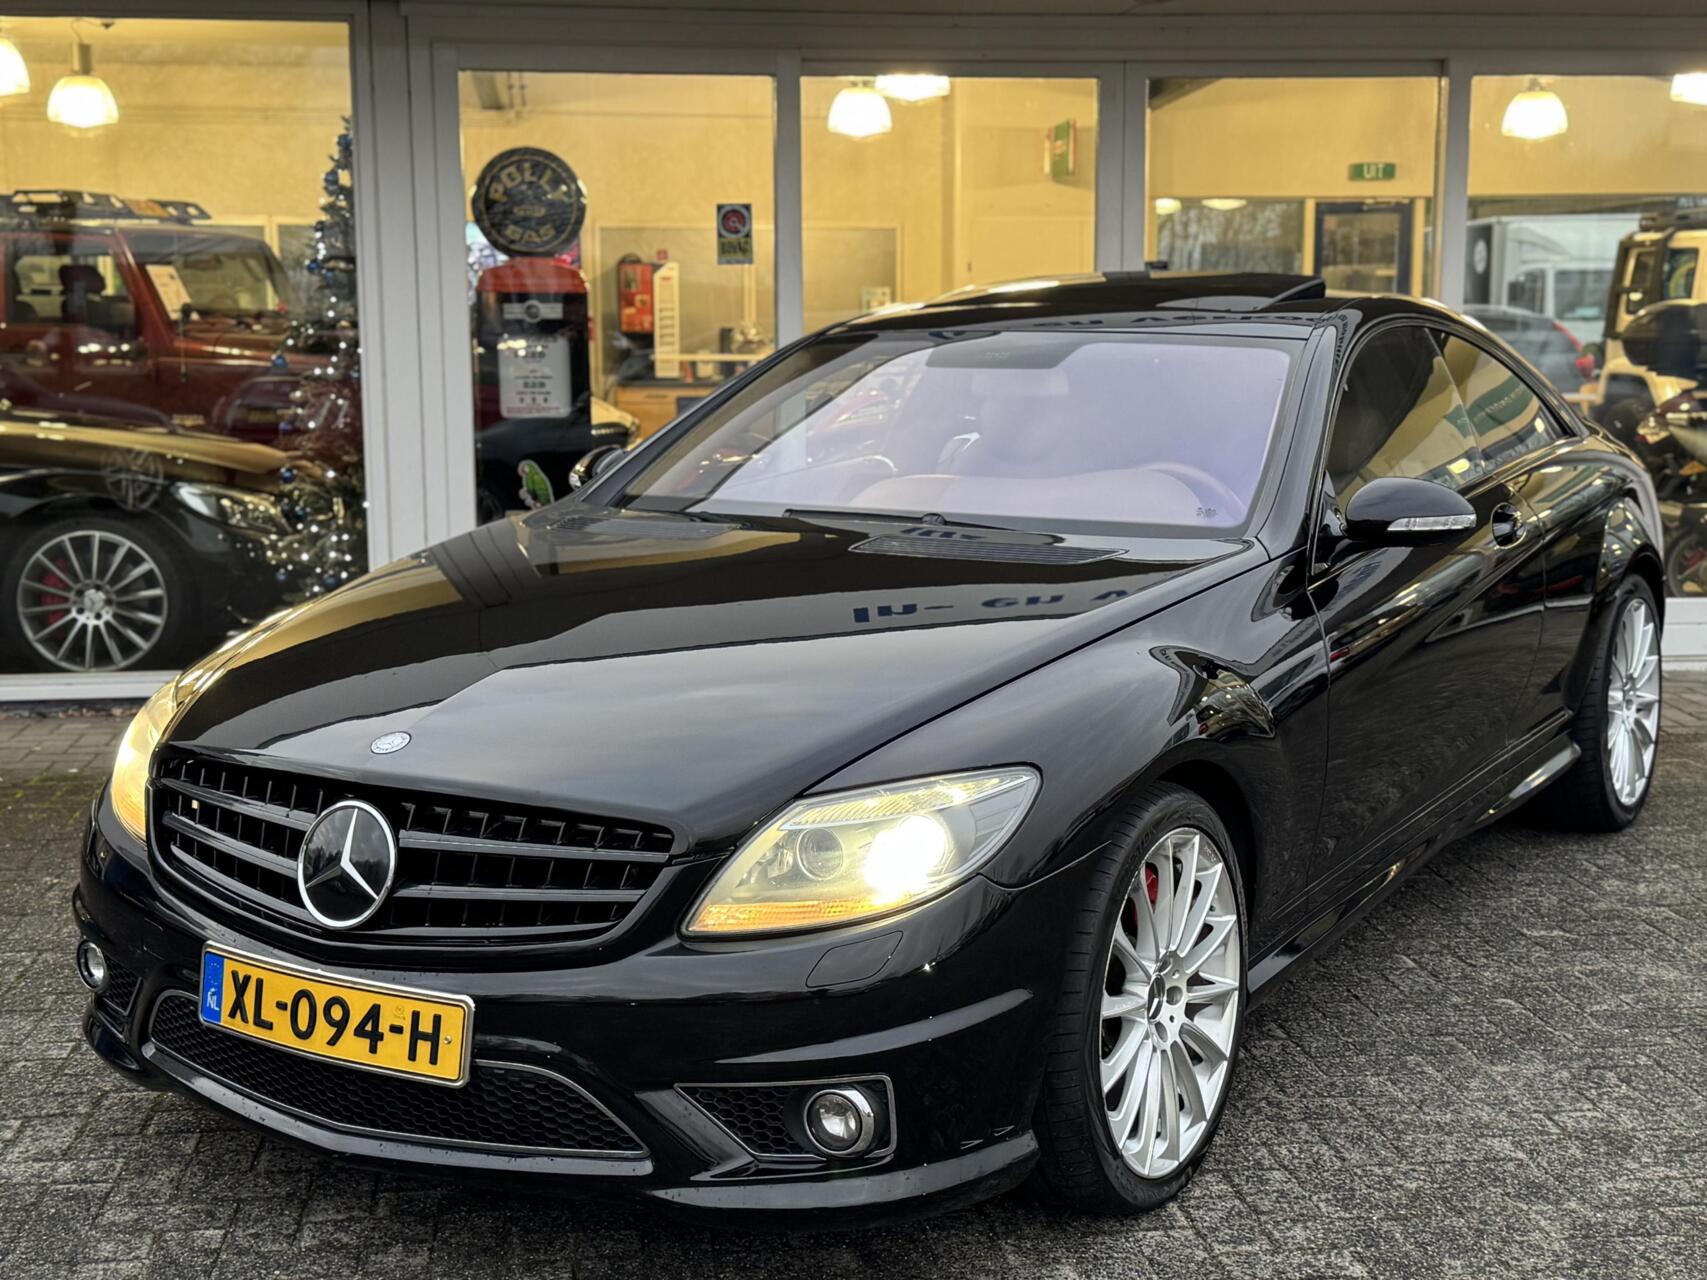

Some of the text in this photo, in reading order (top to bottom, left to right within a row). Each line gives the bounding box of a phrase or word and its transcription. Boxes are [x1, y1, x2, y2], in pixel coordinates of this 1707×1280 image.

[489, 161, 571, 203] POLLY
[1362, 163, 1385, 179] UIT
[505, 224, 557, 243] GAS
[206, 969, 442, 1066] NL XL-094-H
